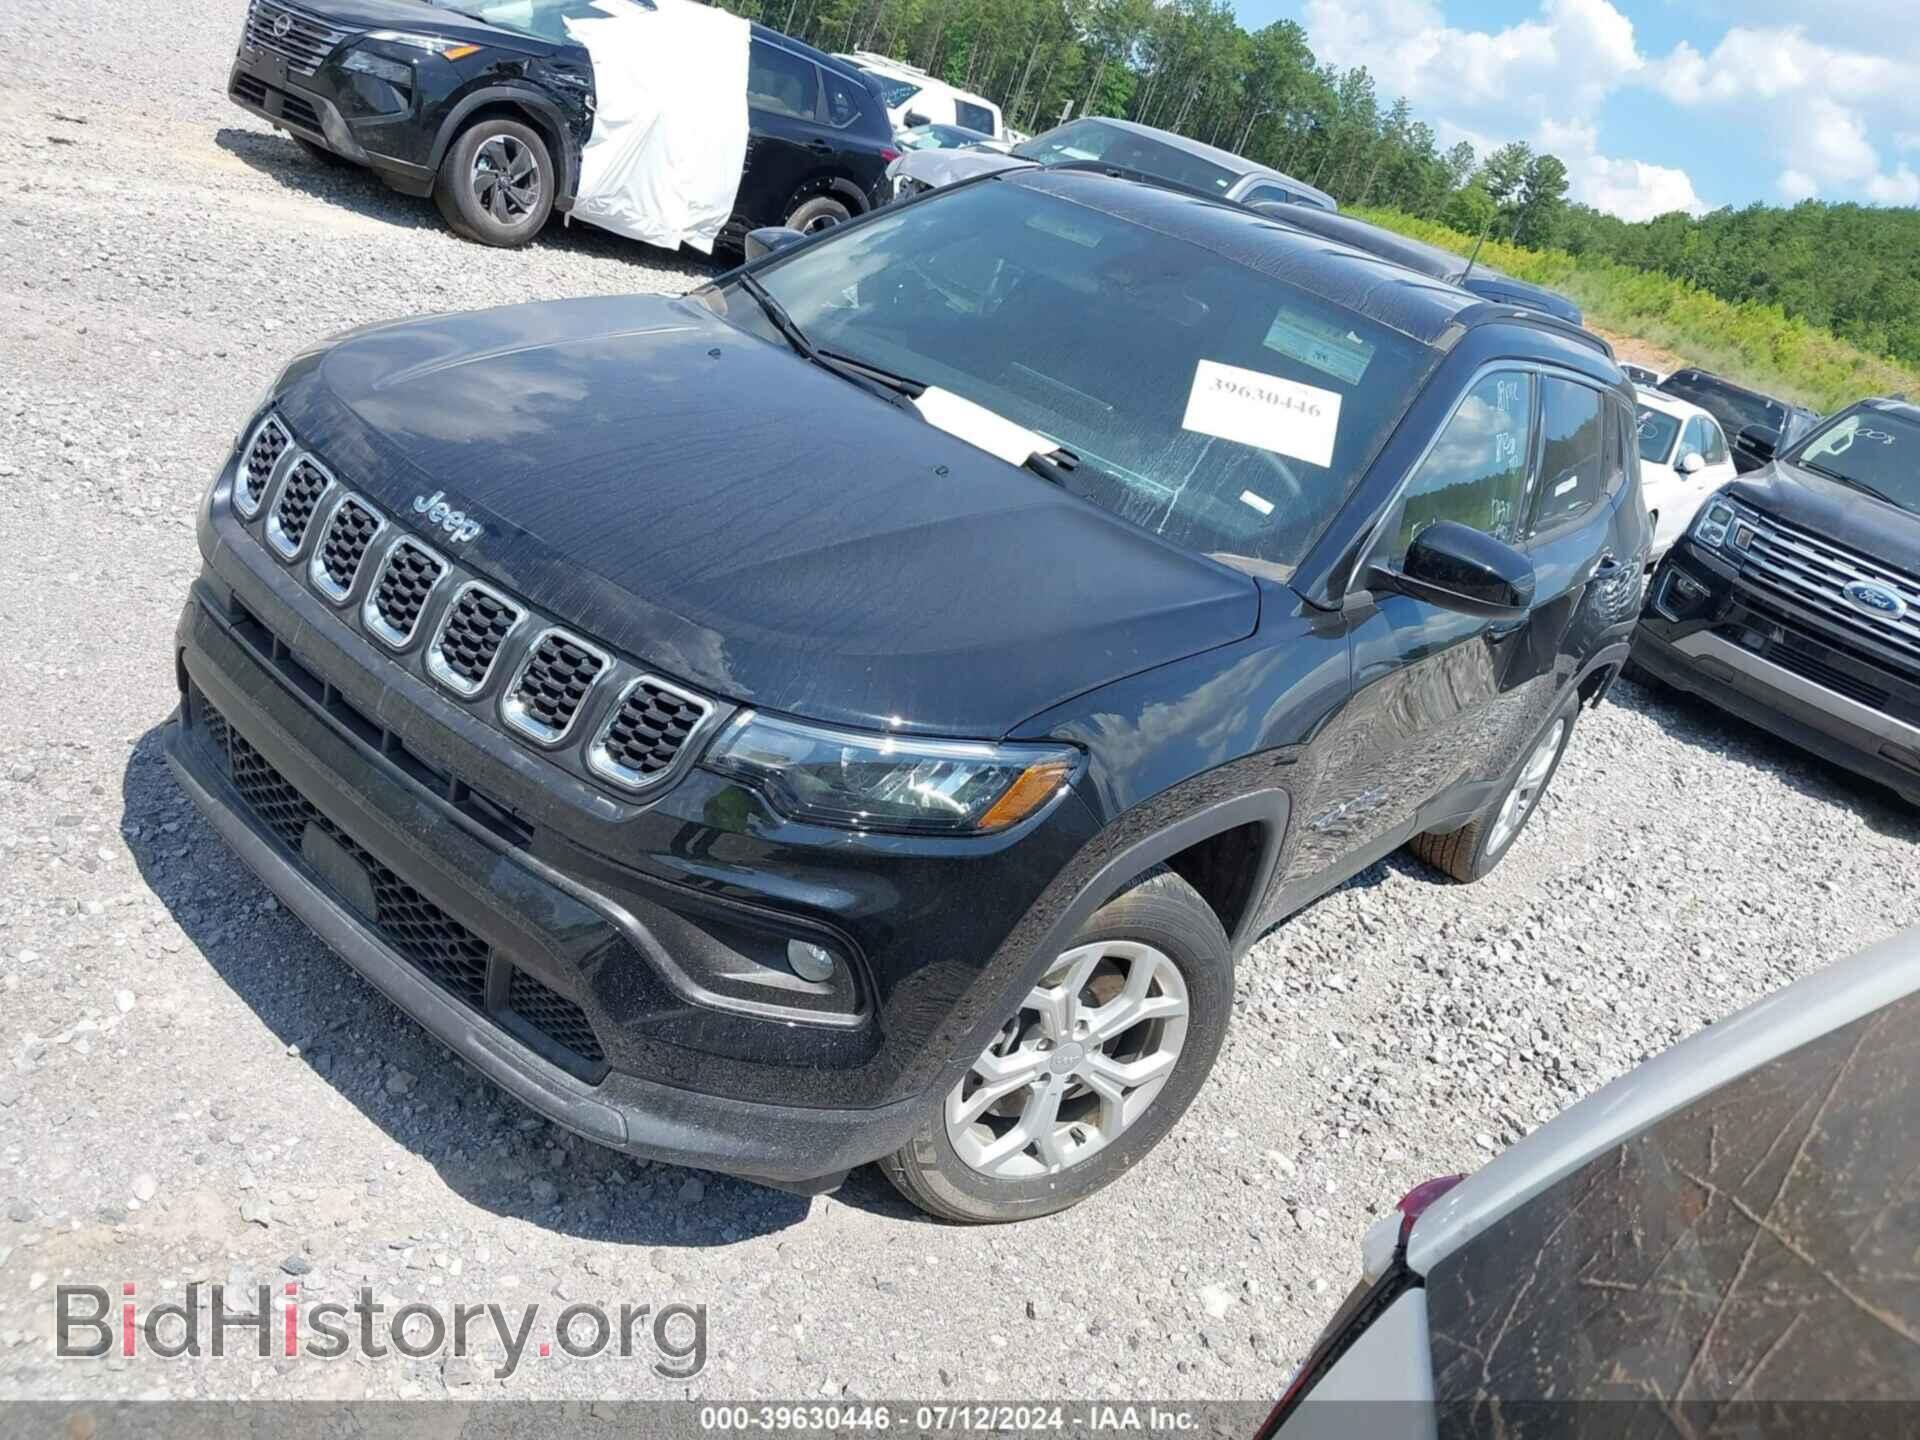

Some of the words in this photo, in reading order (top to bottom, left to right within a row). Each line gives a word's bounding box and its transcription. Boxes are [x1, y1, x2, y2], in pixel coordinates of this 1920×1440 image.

[1210, 378, 1321, 416] 39630446
[413, 490, 482, 543] Jeep
[1858, 589, 1891, 608] Ford
